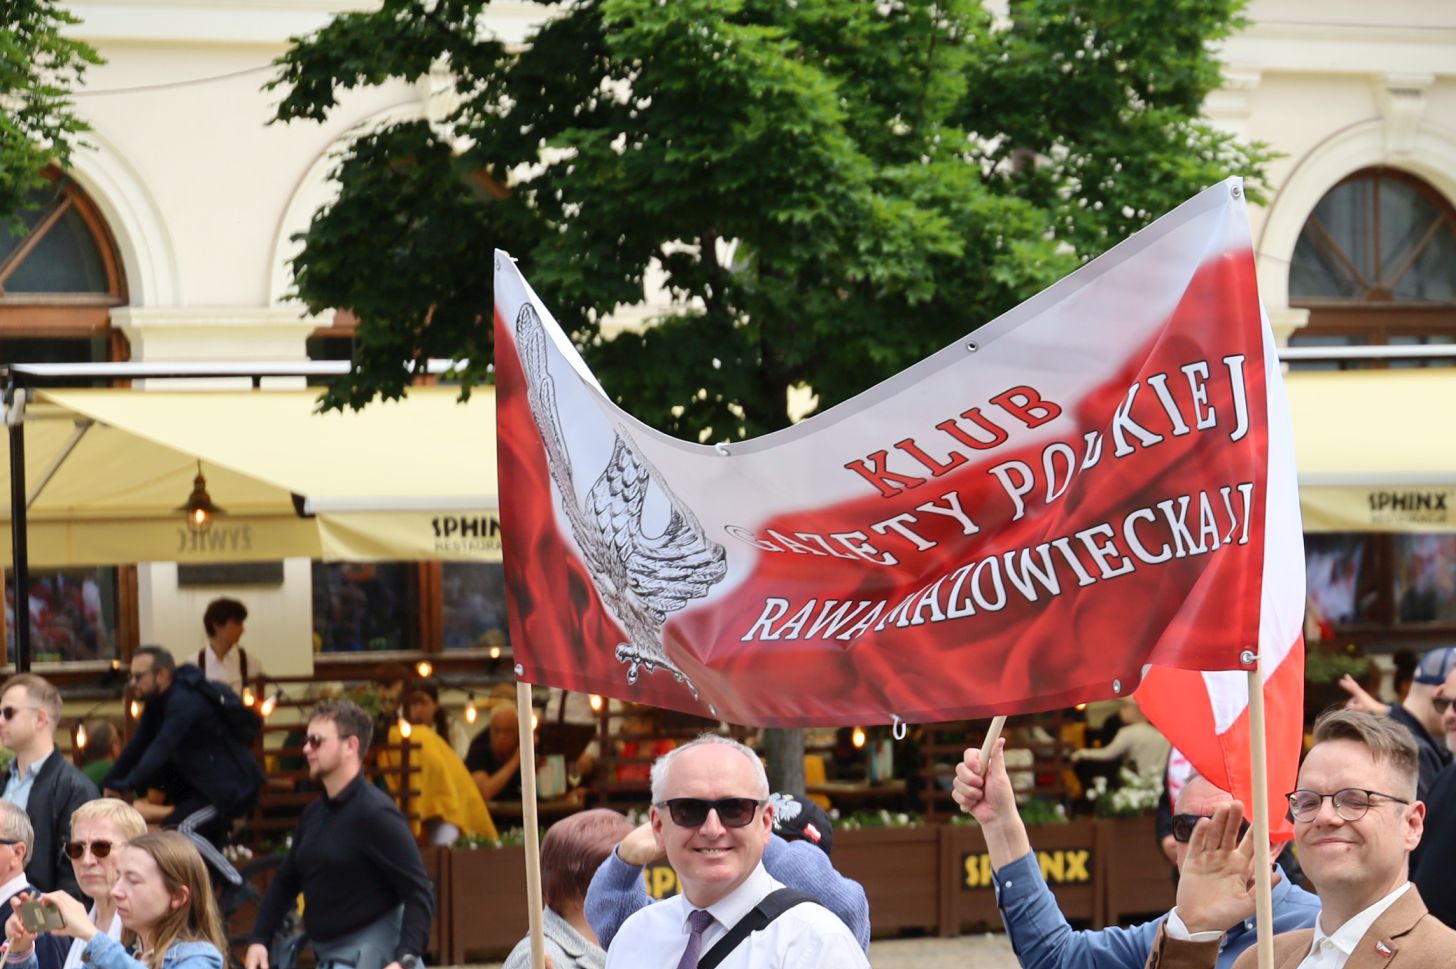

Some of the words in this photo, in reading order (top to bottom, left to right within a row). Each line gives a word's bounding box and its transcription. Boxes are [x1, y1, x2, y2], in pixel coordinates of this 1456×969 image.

[844, 385, 1063, 499] KLUB
[432, 517, 500, 537] SPHIN
[724, 490, 981, 567] GAZETY
[1369, 492, 1447, 511] SPHINX
[740, 597, 888, 642] RAWA
[874, 490, 1223, 633] MAZOWIECKA
